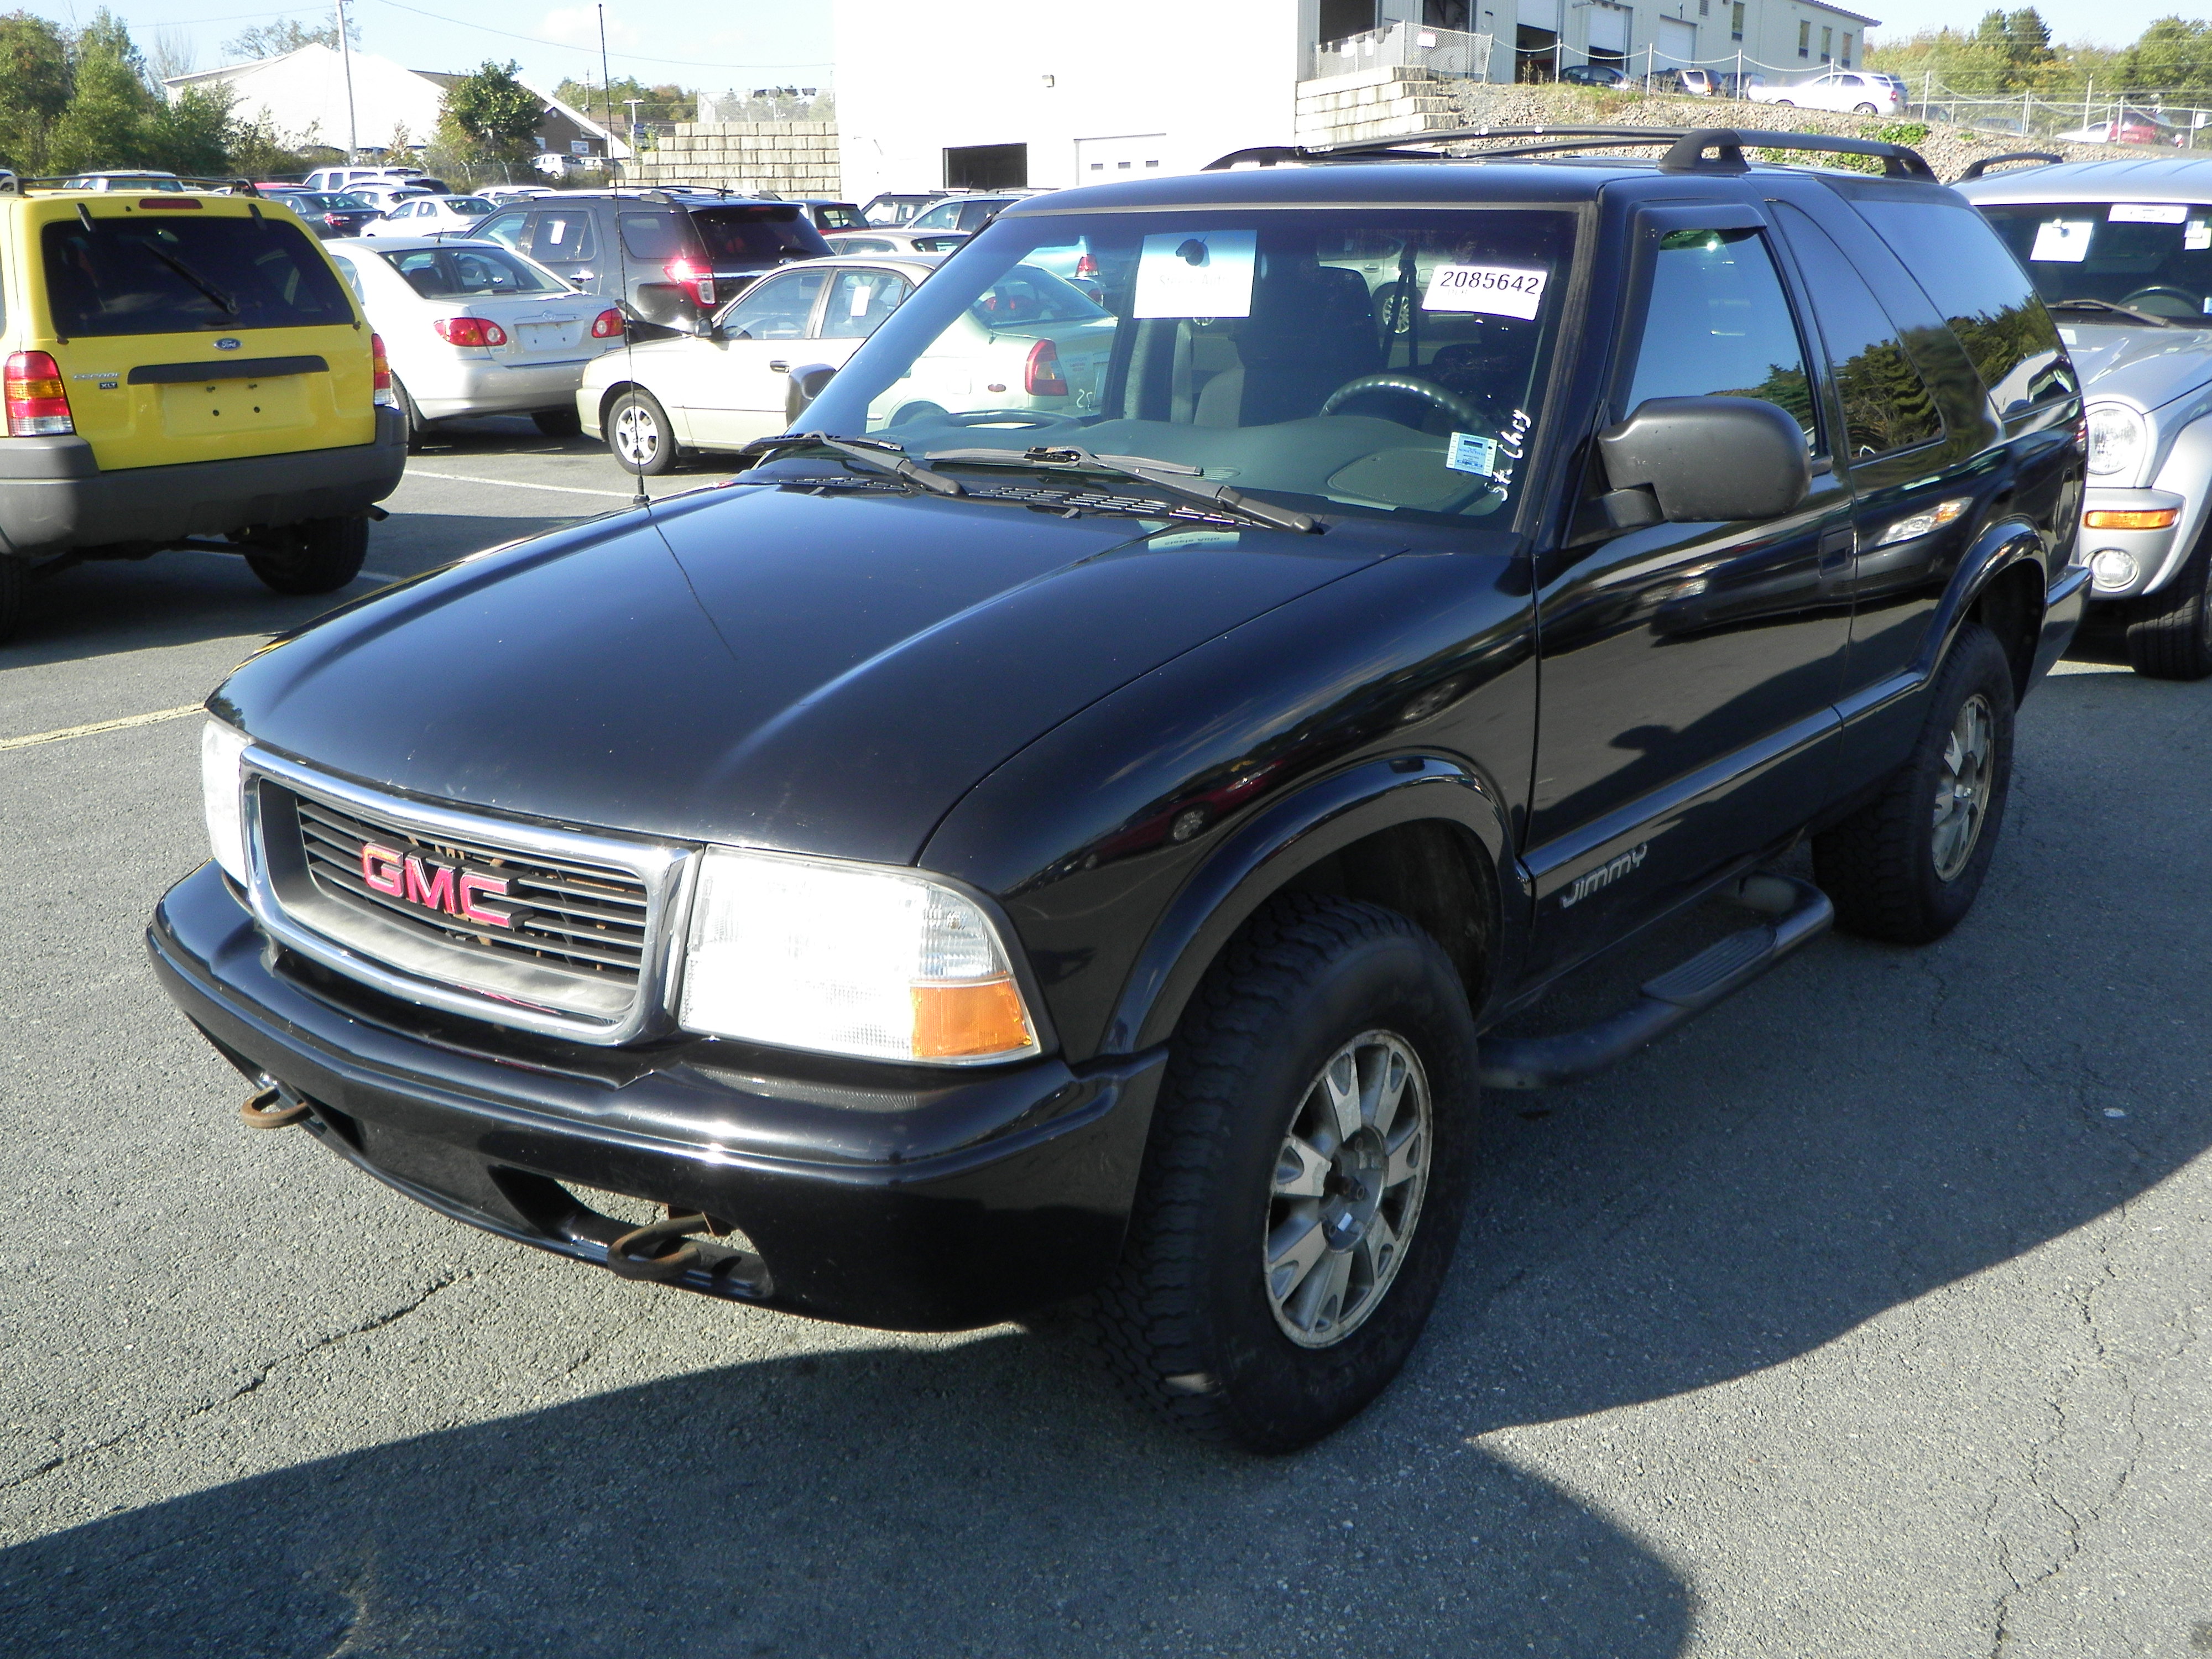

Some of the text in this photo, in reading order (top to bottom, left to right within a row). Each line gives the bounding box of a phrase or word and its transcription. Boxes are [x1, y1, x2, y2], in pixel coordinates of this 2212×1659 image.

[1440, 271, 1539, 295] 2085642
[362, 842, 515, 929] GMC
[1560, 843, 1647, 908] JIMMY
